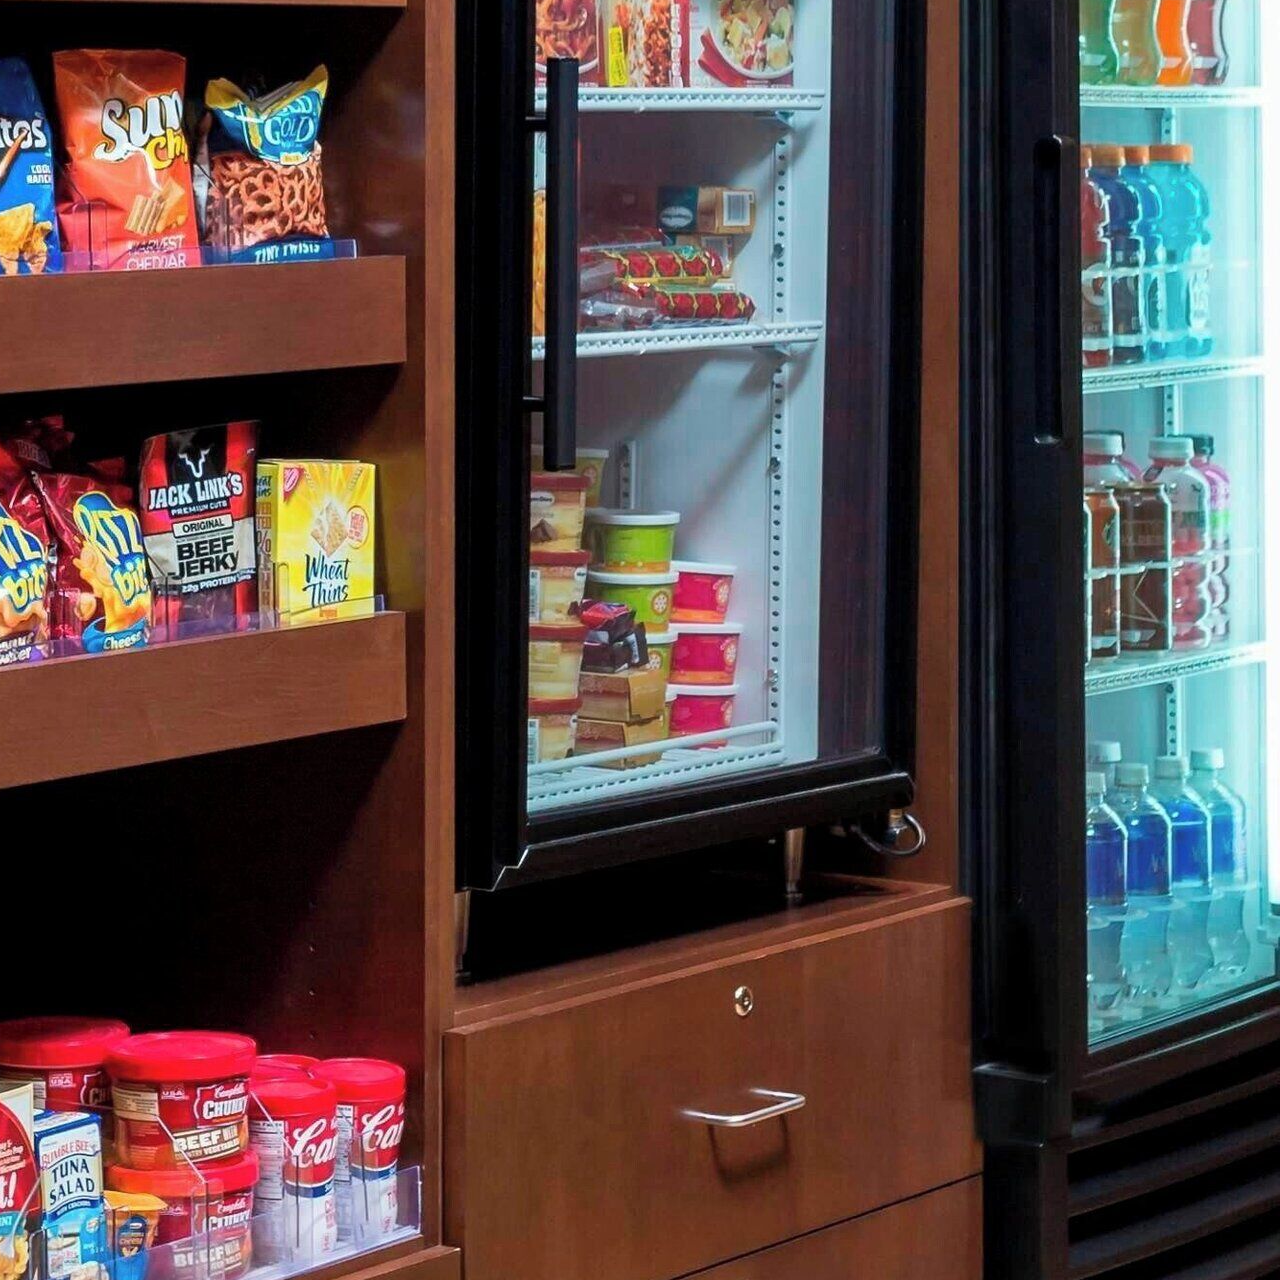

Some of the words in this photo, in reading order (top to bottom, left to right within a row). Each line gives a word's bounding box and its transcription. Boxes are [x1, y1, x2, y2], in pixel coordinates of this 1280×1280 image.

[93, 90, 184, 163] Sun
[264, 115, 315, 147] GOLD
[126, 253, 188, 271] CHEDDAR
[149, 483, 193, 510] JACK
[195, 474, 243, 502] LINK'S
[171, 504, 208, 516] PREMIUM
[209, 500, 228, 510] CUTS
[182, 517, 224, 534] ORIGINAL
[177, 535, 234, 561] BEEF
[167, 551, 239, 581] JERKY
[305, 551, 350, 584] Wheat
[200, 576, 237, 589] PROTEIN
[303, 581, 348, 608] Thins
[42, 1145, 73, 1167] BUMBLE
[74, 1140, 90, 1152] BEE
[173, 1129, 221, 1152] BEEF
[52, 1159, 90, 1183] TUNA
[49, 1177, 95, 1206] SALAD
